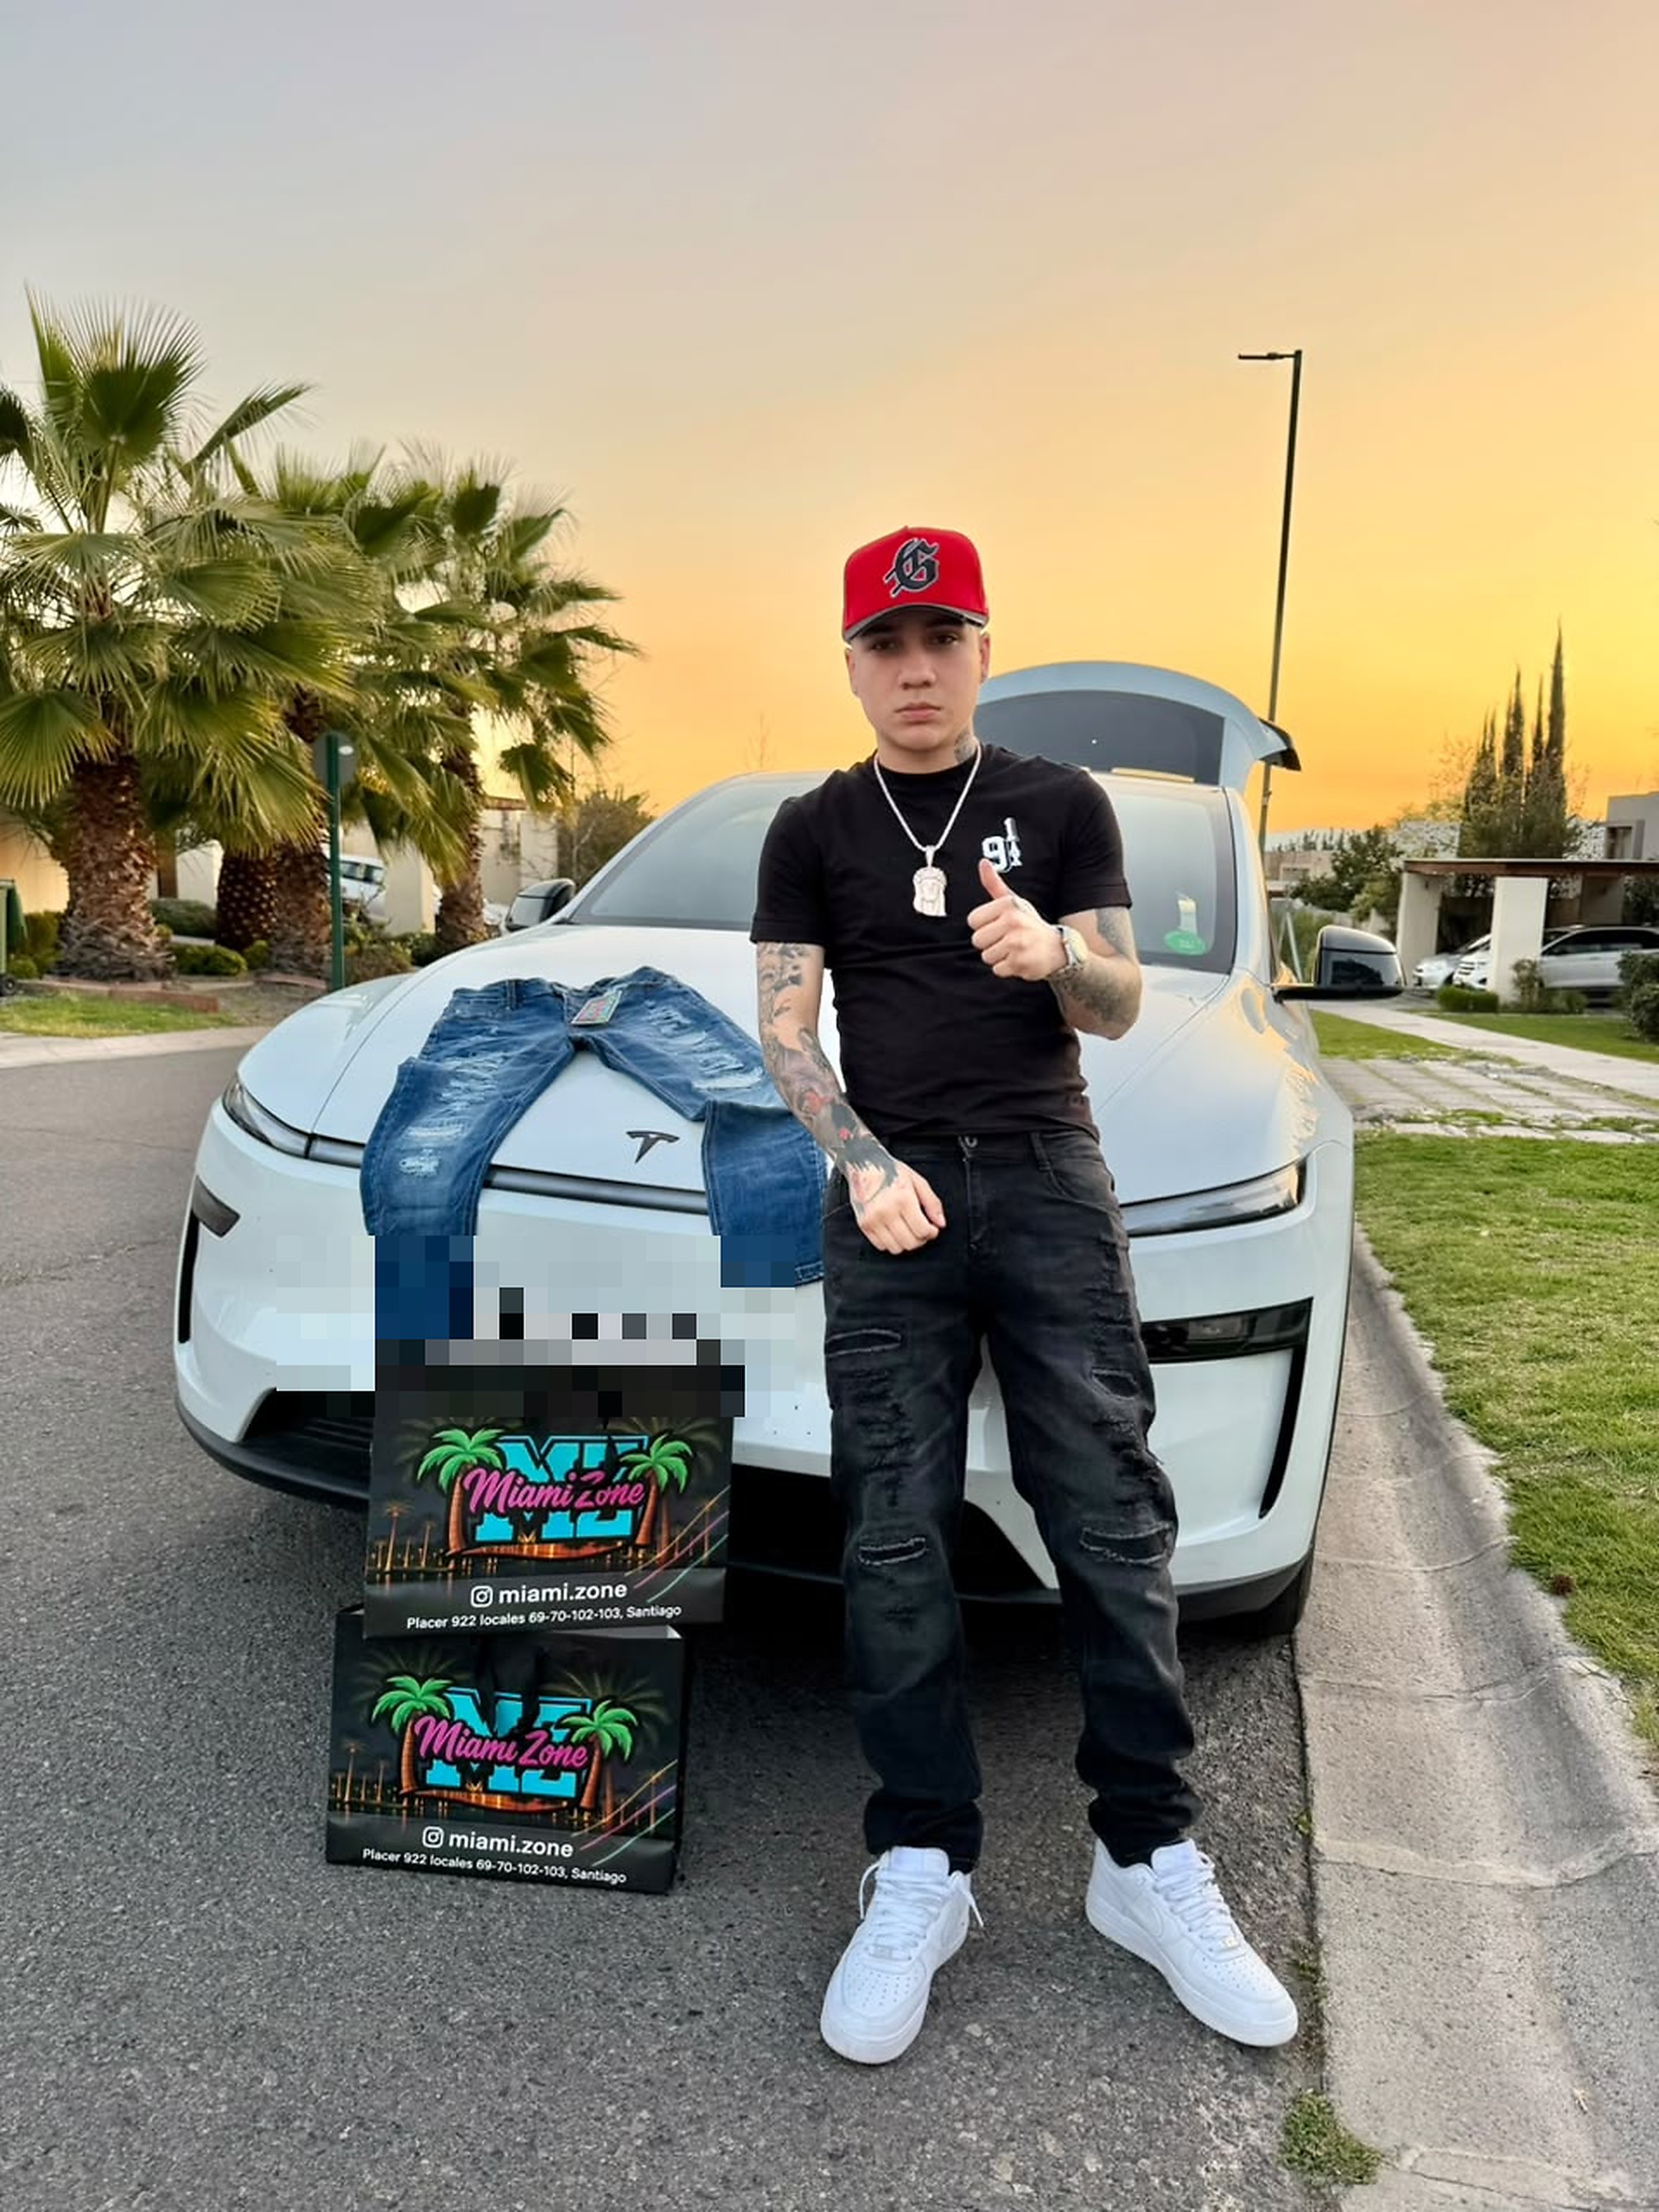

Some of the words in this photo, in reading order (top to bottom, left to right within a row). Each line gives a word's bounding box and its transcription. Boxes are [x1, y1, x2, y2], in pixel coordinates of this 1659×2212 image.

[463, 1468, 576, 1514] Miami
[574, 1471, 645, 1509] Zone
[499, 1582, 627, 1604] miami.zone
[407, 1616, 448, 1629] Placer
[451, 1615, 476, 1627] 922
[480, 1612, 525, 1625] locales
[529, 1608, 624, 1624] 69-70-102-103,
[626, 1605, 683, 1619] Santiago
[414, 1715, 518, 1762] Miami
[518, 1729, 588, 1767] Zone
[448, 1832, 574, 1858] miami.zone
[362, 1848, 400, 1862] Placer
[404, 1852, 427, 1865] 922
[430, 1854, 473, 1870] locales
[476, 1859, 568, 1878] 69-70-102-103,
[571, 1867, 626, 1885] Santiago
